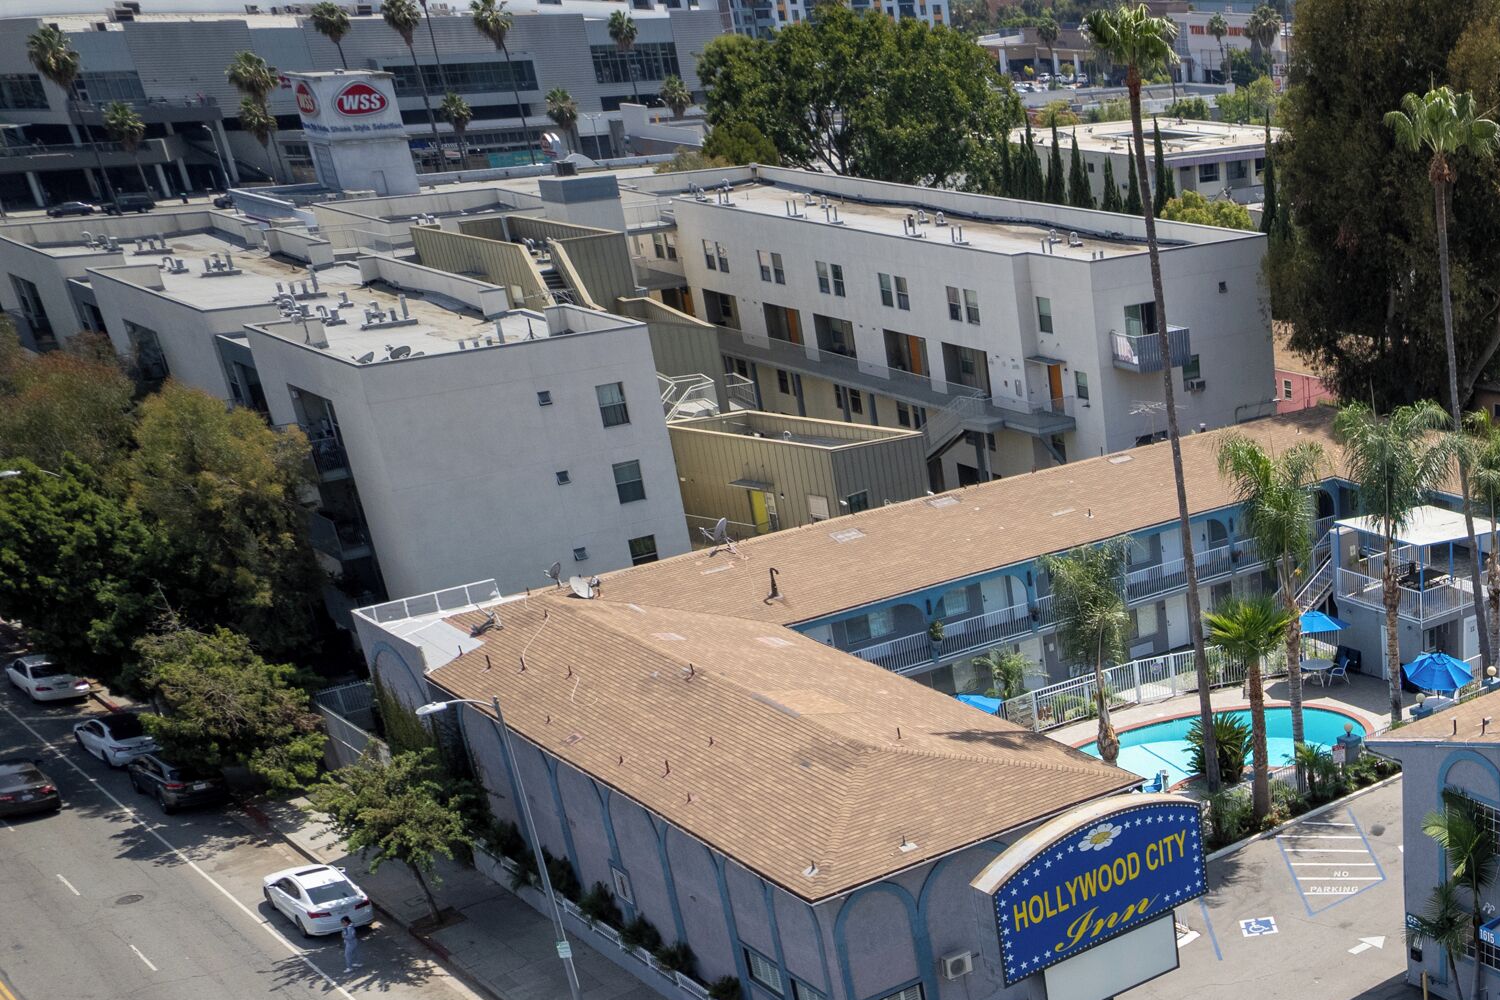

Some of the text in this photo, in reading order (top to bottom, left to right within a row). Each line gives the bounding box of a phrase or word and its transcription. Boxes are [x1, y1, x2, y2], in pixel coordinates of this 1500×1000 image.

[339, 93, 381, 110] WSS
[1013, 829, 1187, 932] HOLLYWOOD CITY
[1055, 893, 1161, 953] Inn
[1480, 928, 1495, 944] 1615
